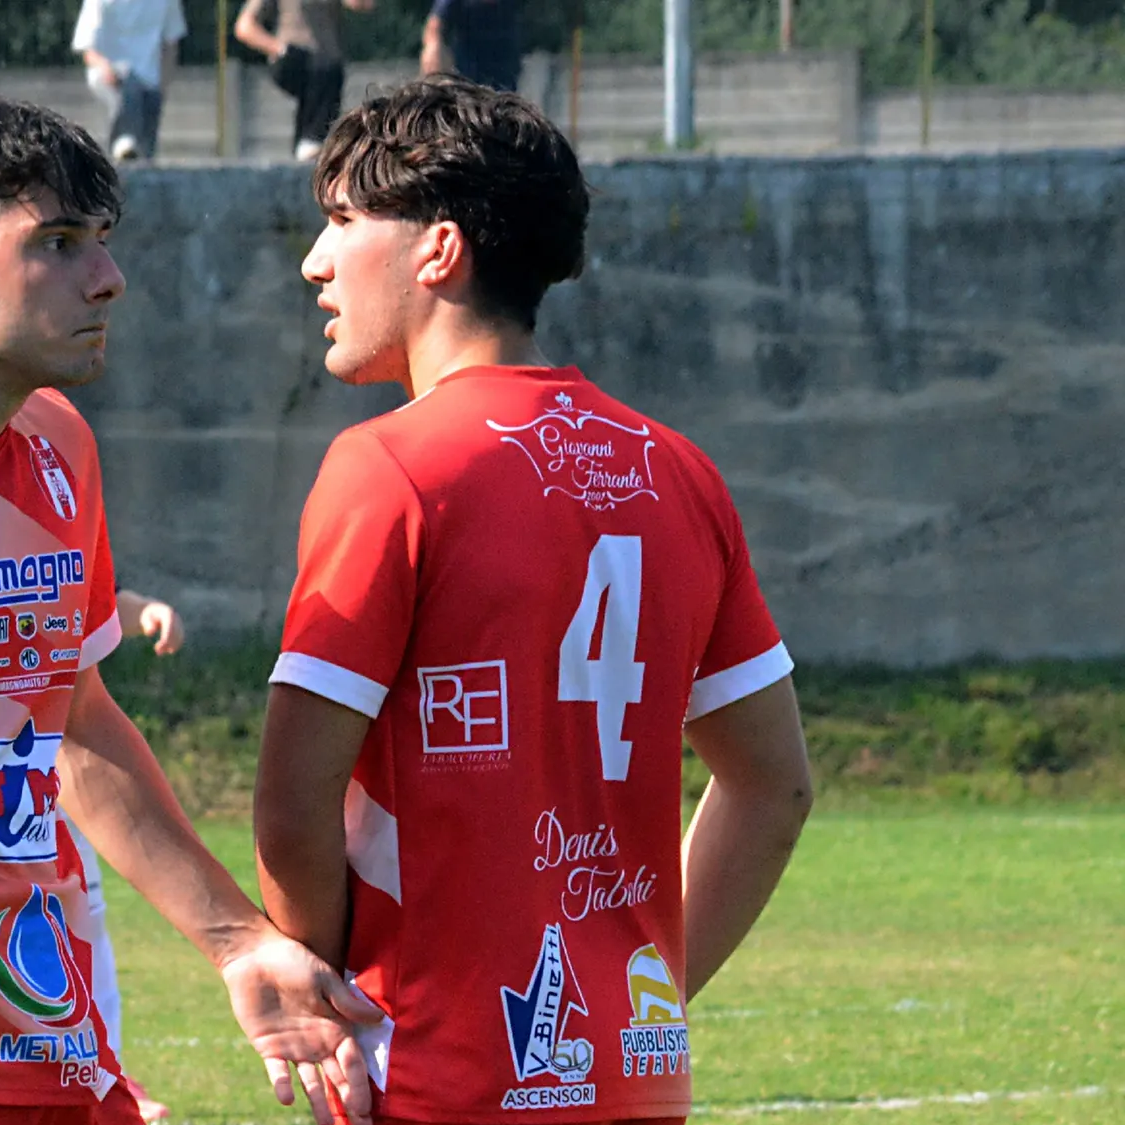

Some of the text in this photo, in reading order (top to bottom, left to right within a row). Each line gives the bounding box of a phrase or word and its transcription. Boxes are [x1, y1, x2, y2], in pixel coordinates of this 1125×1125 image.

[534, 425, 615, 472] Giovanni
[572, 456, 643, 489] Ferrante
[44, 615, 68, 631] Jeep
[558, 534, 645, 781] 4
[534, 806, 619, 871] Denis
[504, 1086, 594, 1106] ASCENSORI
